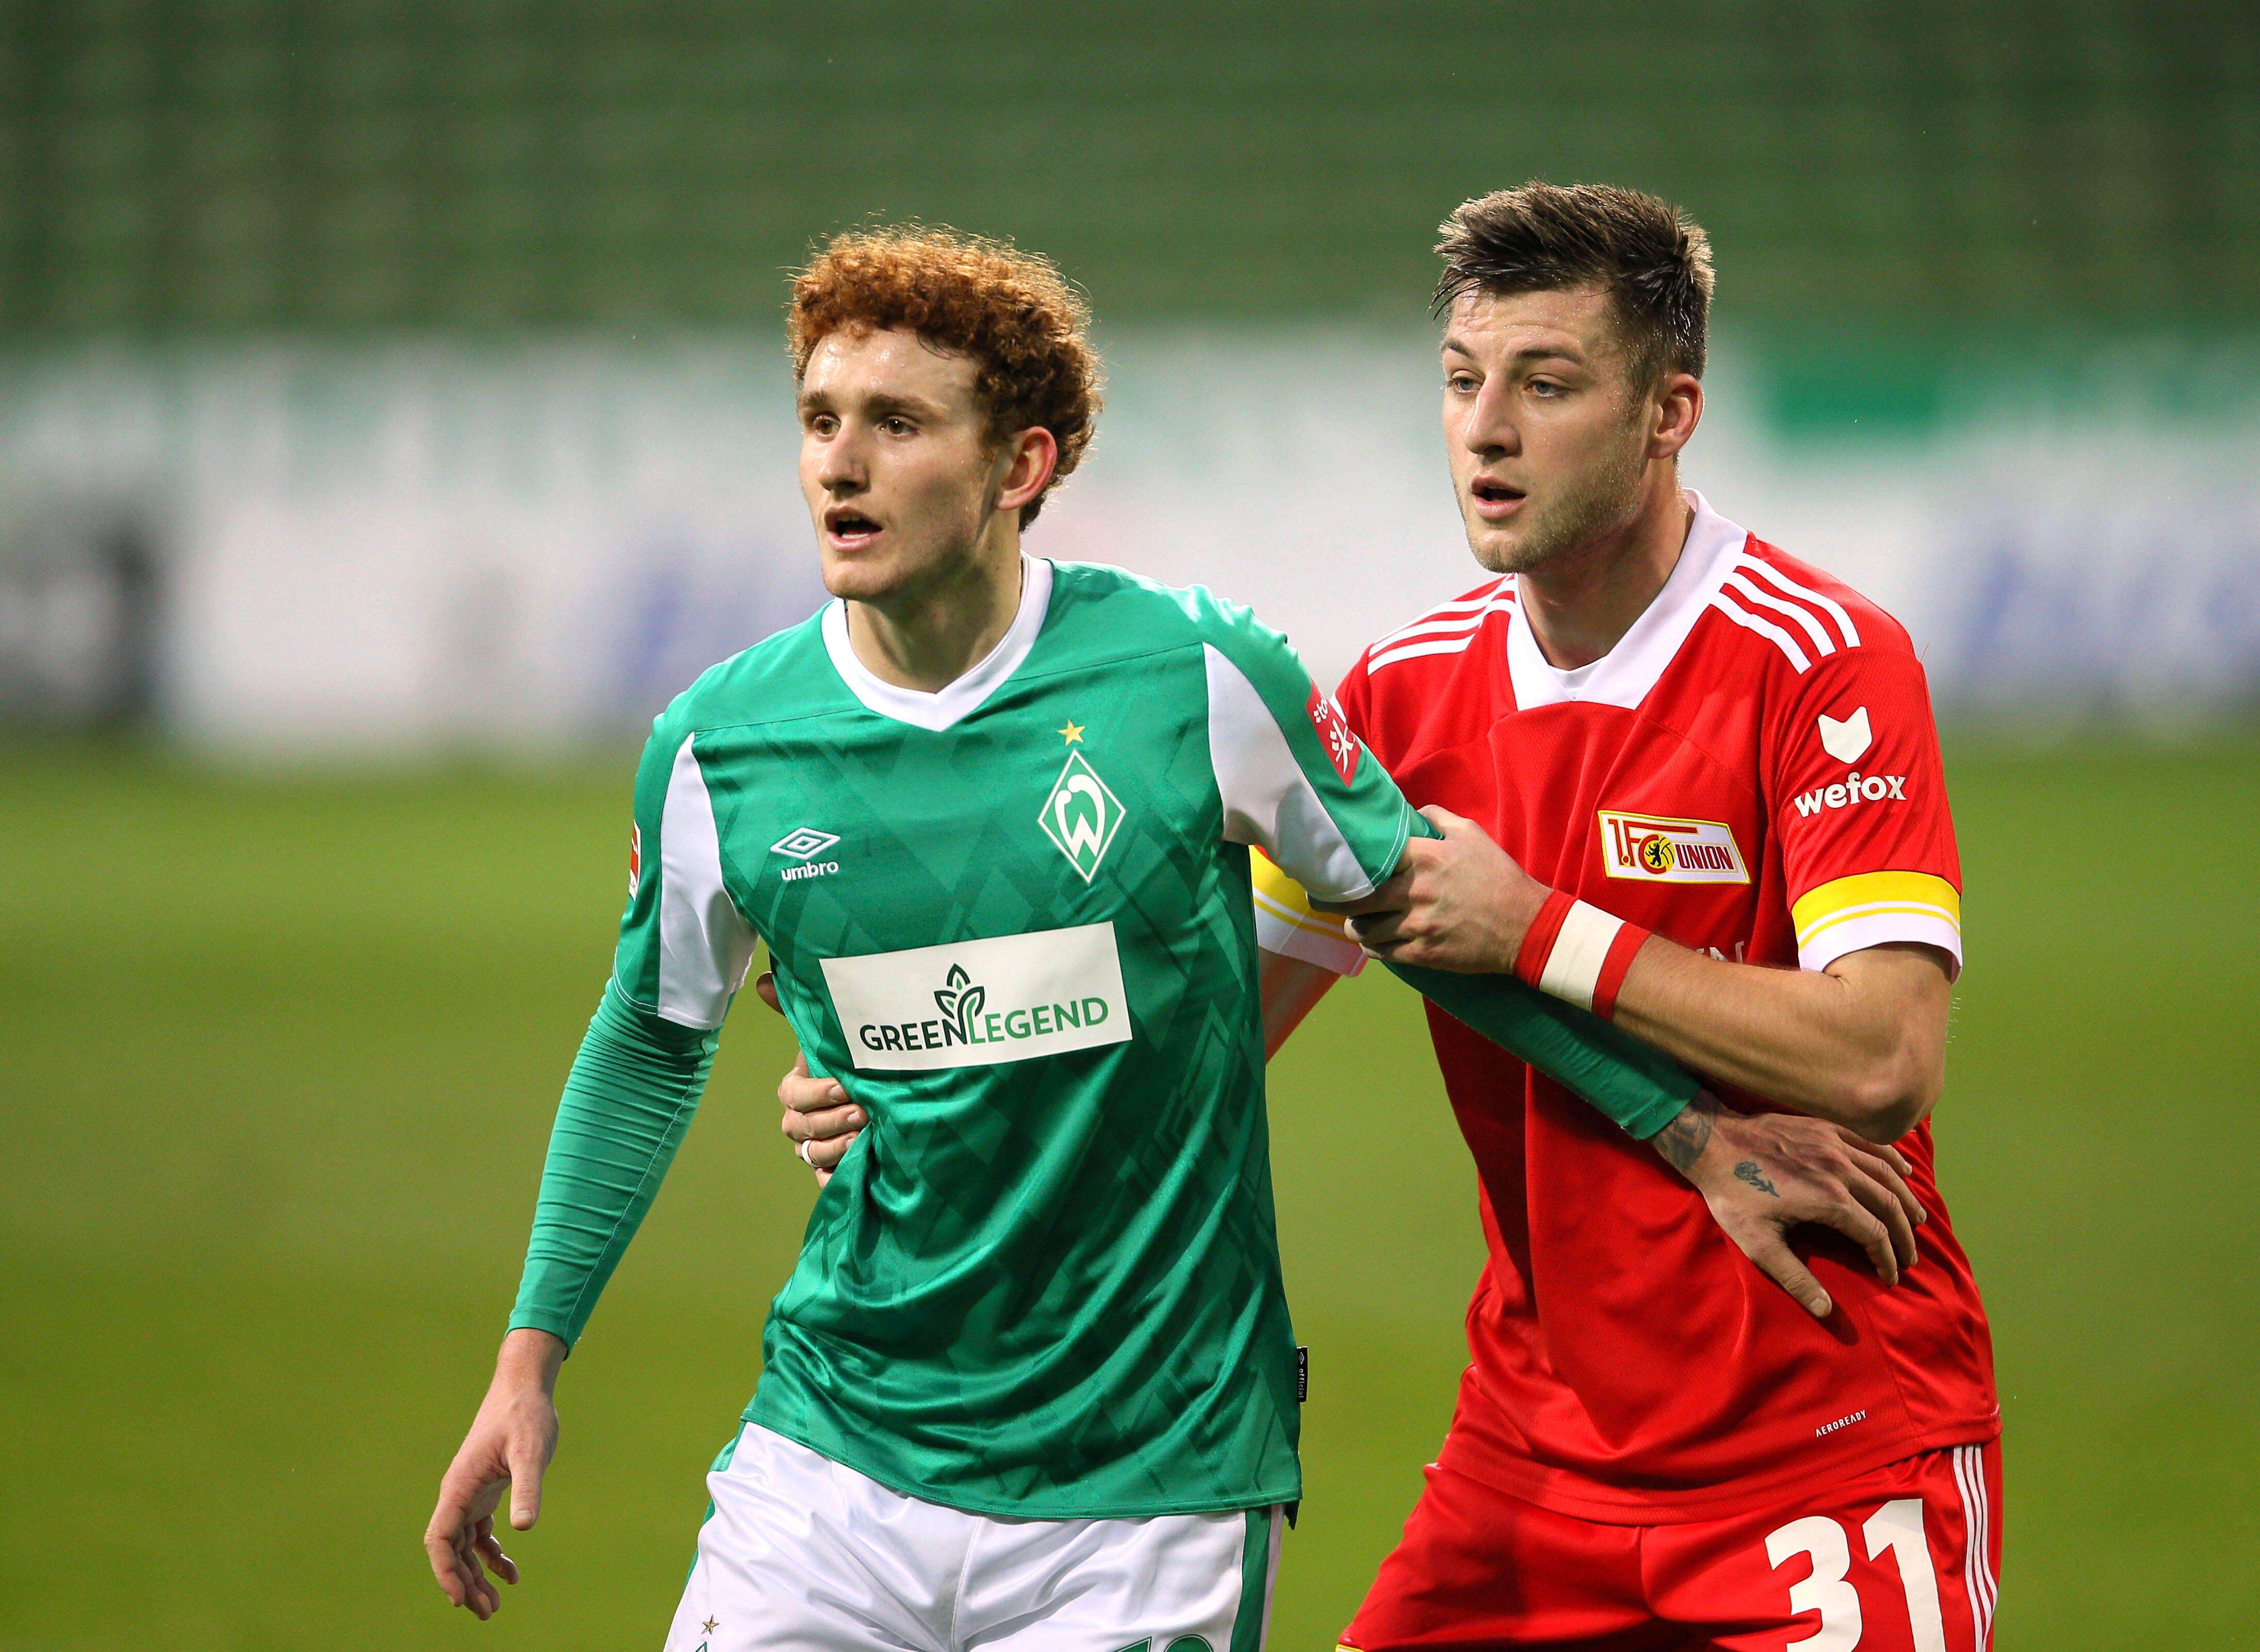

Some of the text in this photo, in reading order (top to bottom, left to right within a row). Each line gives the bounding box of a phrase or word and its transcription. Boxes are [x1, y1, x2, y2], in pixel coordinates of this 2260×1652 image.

[1794, 771, 1907, 818] wefox
[781, 861, 839, 881] umbro
[1675, 844, 1734, 870] UNION
[1815, 1409, 1866, 1438] AEROREADY
[1764, 1498, 1946, 1652] 31
